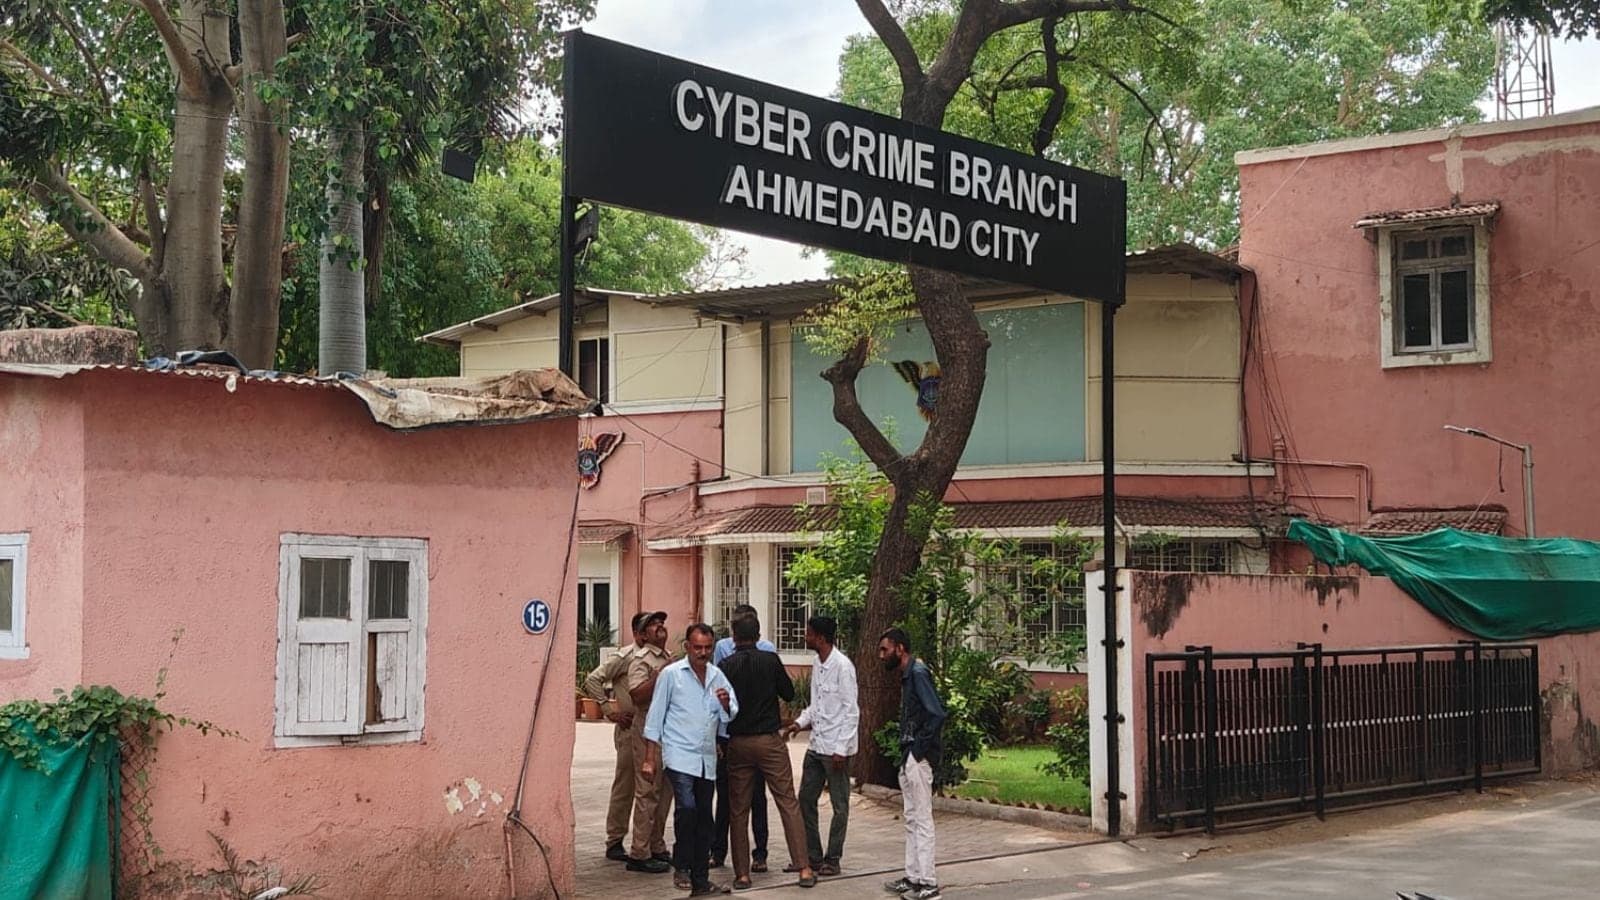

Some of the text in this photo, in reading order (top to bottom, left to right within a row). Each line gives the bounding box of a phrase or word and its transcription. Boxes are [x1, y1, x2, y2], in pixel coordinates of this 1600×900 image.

[675, 79, 1078, 224] CYBER CRIME BRANCH
[725, 165, 1040, 266] AHMEDABAD CITY
[528, 604, 546, 628] 15
